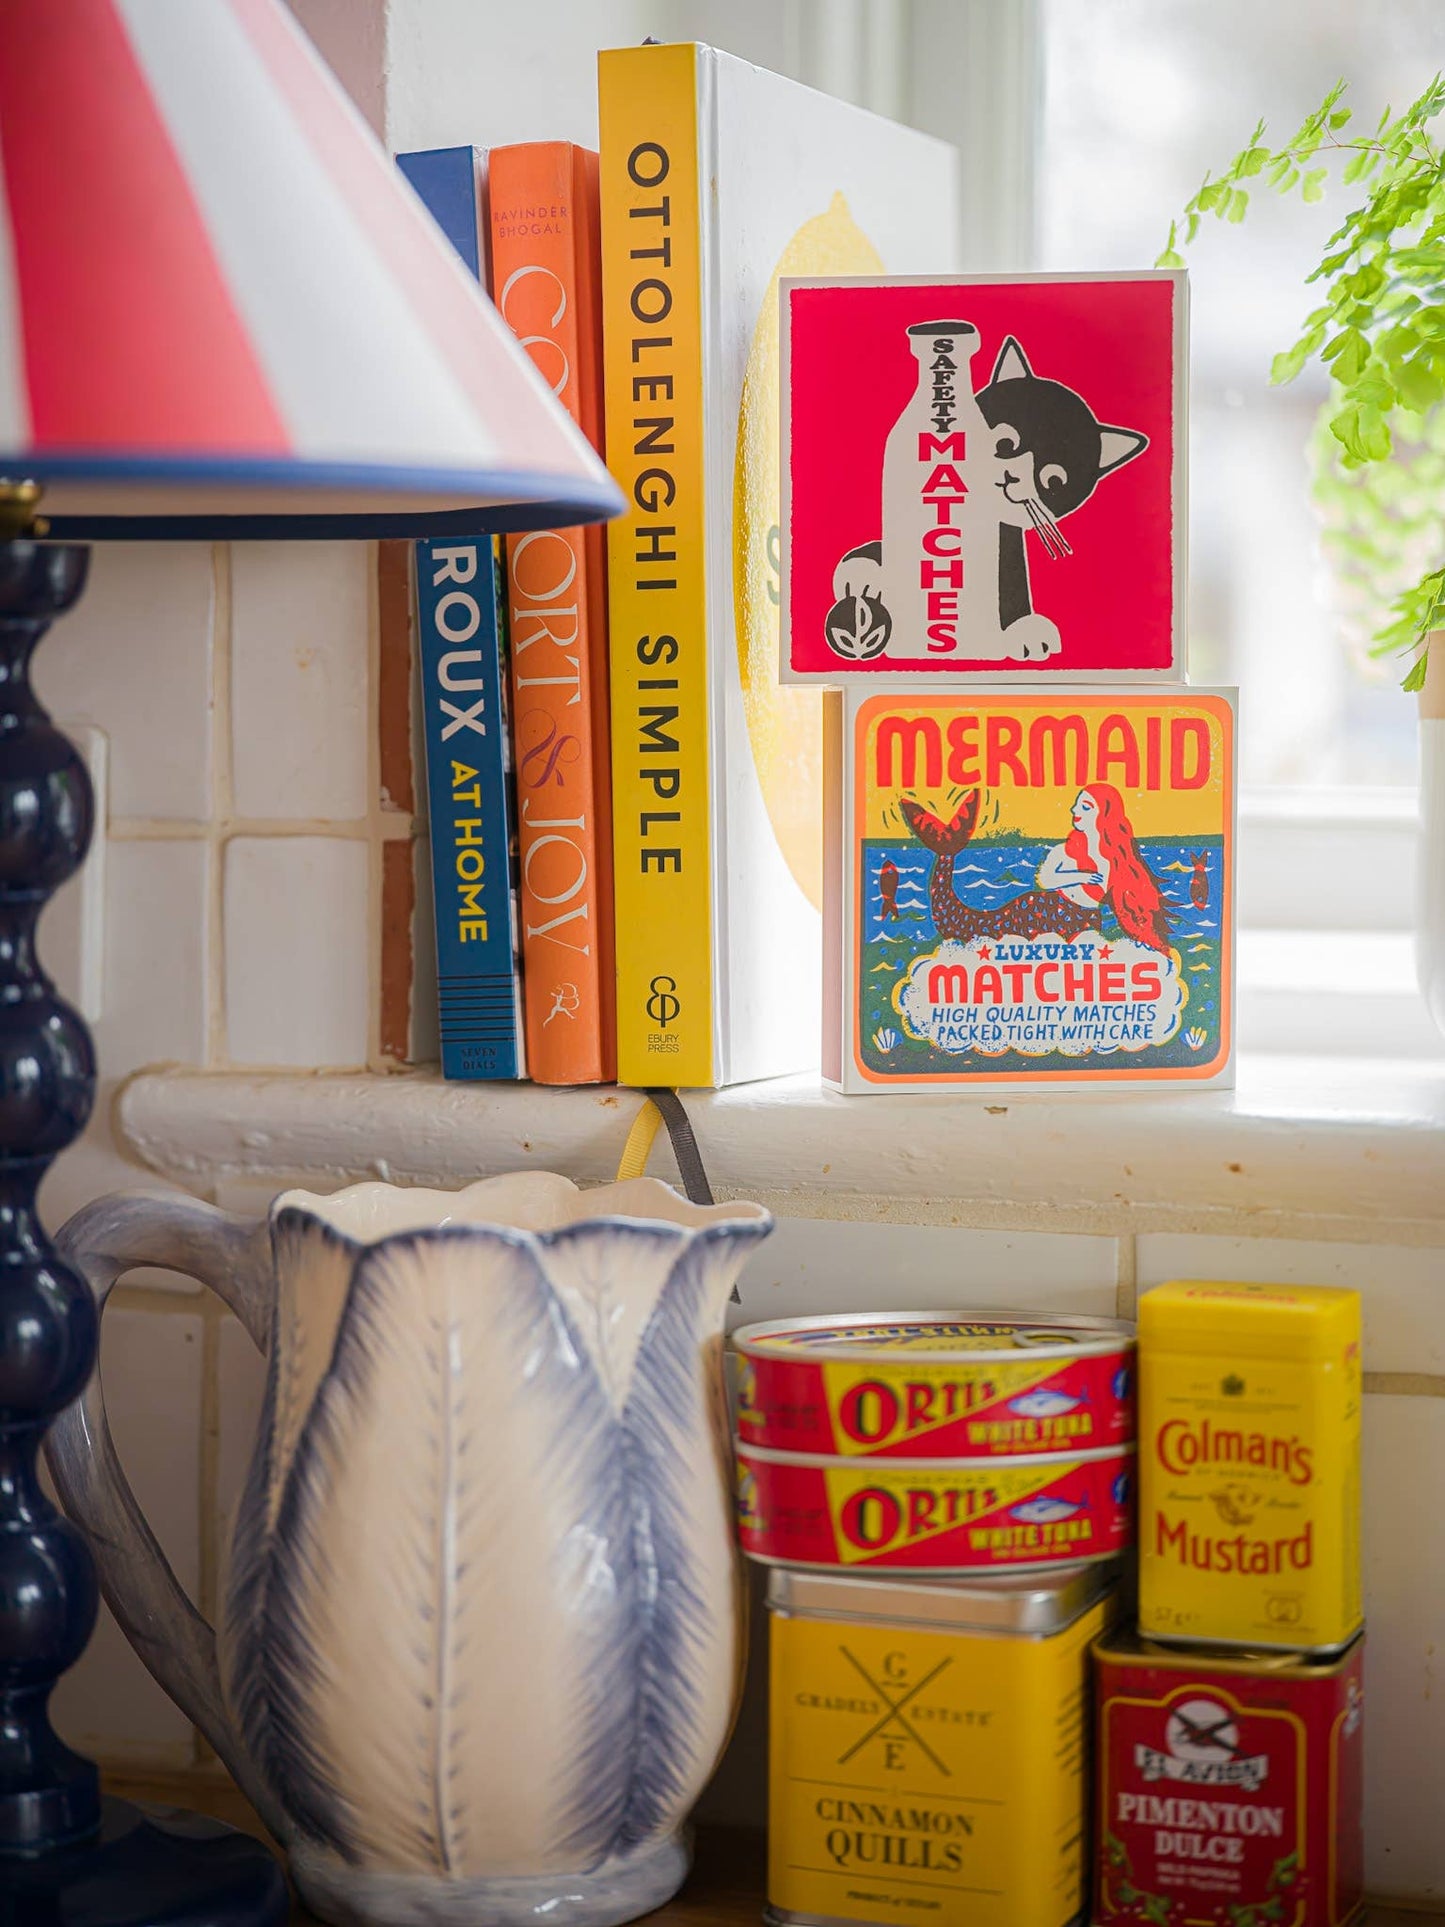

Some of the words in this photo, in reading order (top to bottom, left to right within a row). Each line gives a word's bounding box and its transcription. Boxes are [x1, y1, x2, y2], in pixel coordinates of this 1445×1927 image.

[493, 206, 568, 222] RAVINDER
[499, 222, 562, 238] BHOGAL
[626, 142, 677, 590] OTTOLENGHI
[929, 338, 958, 433] SAFETY
[918, 432, 969, 653] MATCHES
[431, 545, 487, 741] ROUX
[636, 634, 682, 874] SIMPLE
[876, 714, 1211, 791] MERMAID
[450, 760, 482, 808] AT
[454, 817, 489, 943] HOME
[522, 797, 590, 957] JOY
[994, 944, 1096, 961] LUXURY
[928, 961, 1162, 1004] MATCHES
[932, 1007, 978, 1023] HIGH
[986, 1006, 1067, 1024] QUALITY
[1073, 1004, 1157, 1022] MATCHES
[937, 1024, 1003, 1041] PACKED
[1007, 1024, 1058, 1040] TIGHT
[1061, 1024, 1106, 1040] WITH
[1110, 1024, 1154, 1040] CARE
[461, 1047, 497, 1058] SEVEN
[648, 1034, 680, 1043] EBURY
[648, 1044, 680, 1053] PRESS
[463, 1060, 497, 1070] DIALS
[1156, 1418, 1314, 1486] Colman's
[1155, 1510, 1314, 1576] Mustard
[815, 1797, 976, 1837] CINNAMON
[1117, 1791, 1285, 1837] PIMENTON
[825, 1828, 964, 1873] QUILLS
[1154, 1830, 1246, 1863] DULCE
